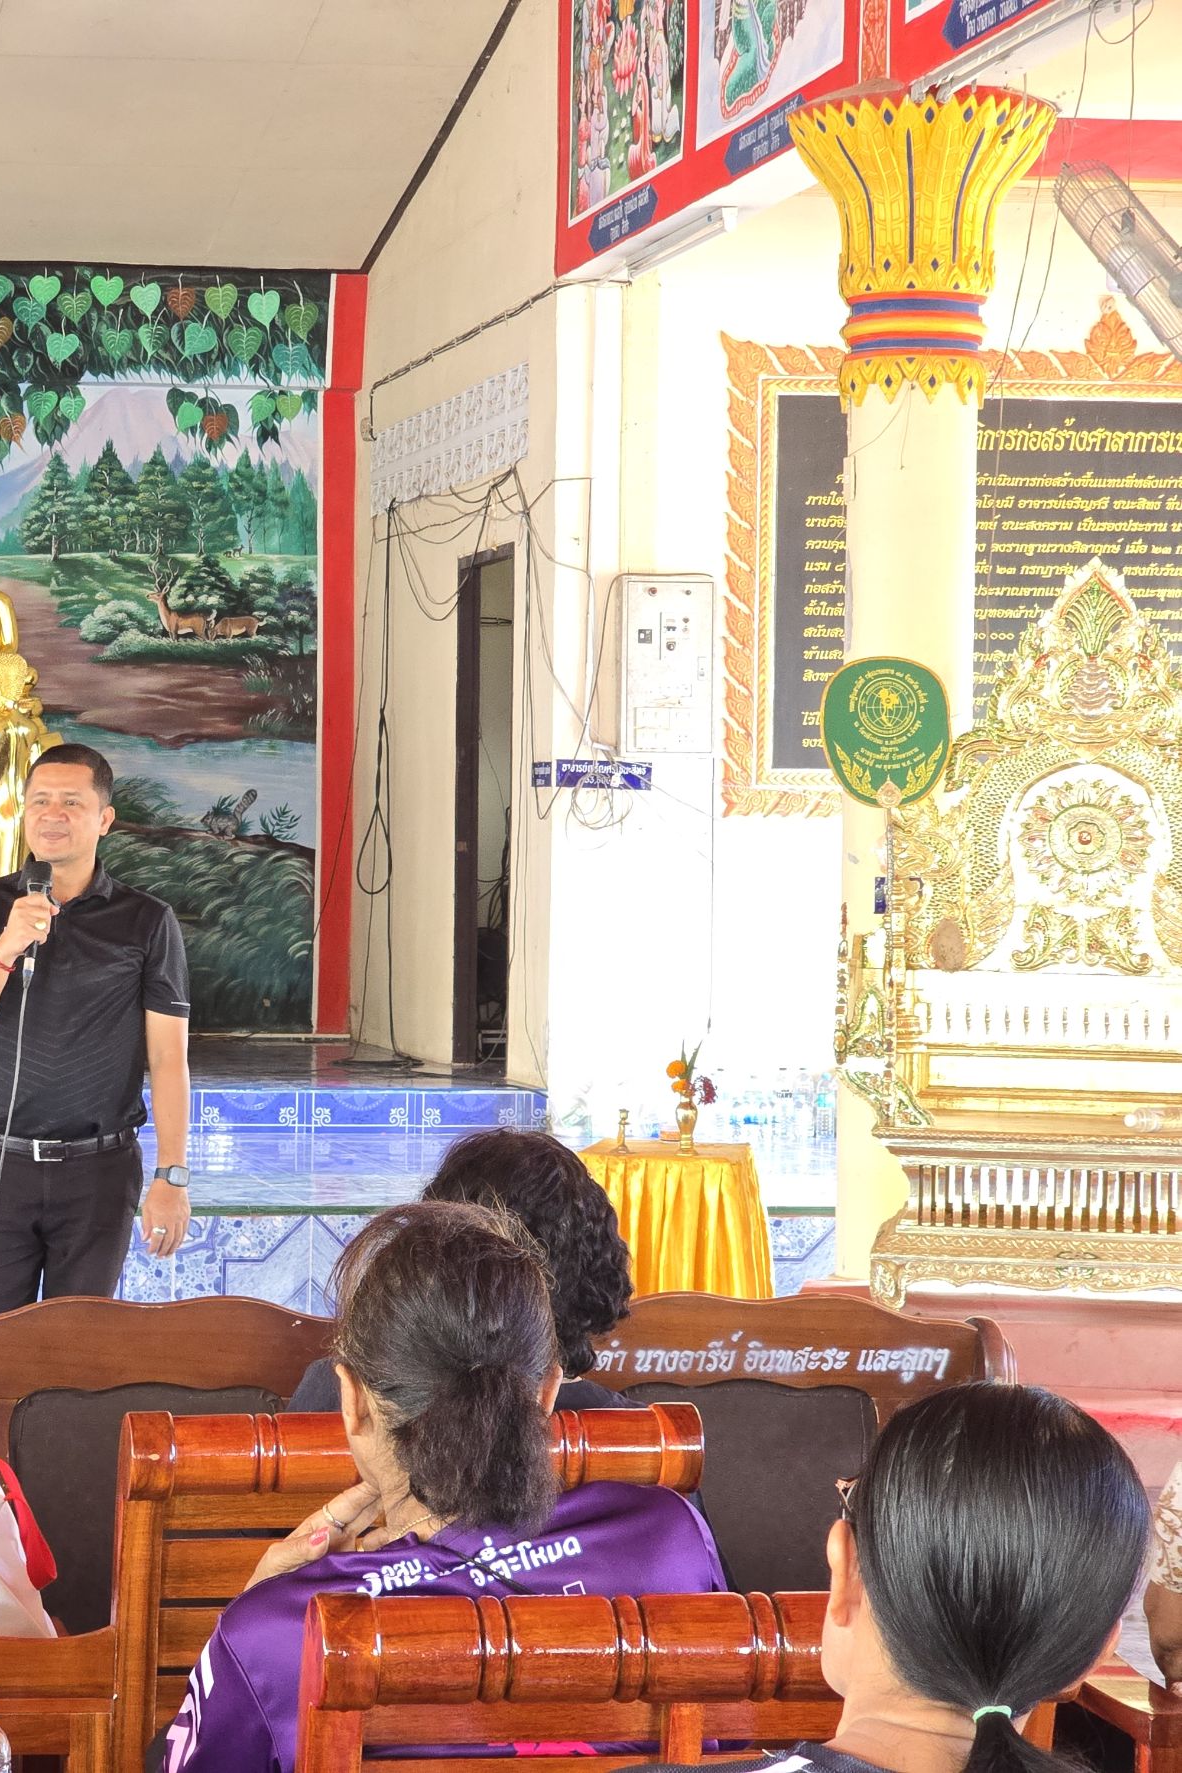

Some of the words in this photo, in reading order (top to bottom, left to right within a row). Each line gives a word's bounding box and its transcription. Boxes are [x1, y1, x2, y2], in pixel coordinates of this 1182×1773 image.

[1125, 538, 1148, 554] เมื่อ
[635, 1331, 743, 1373] นางอารีย์
[856, 1349, 950, 1384] และลูกๆ
